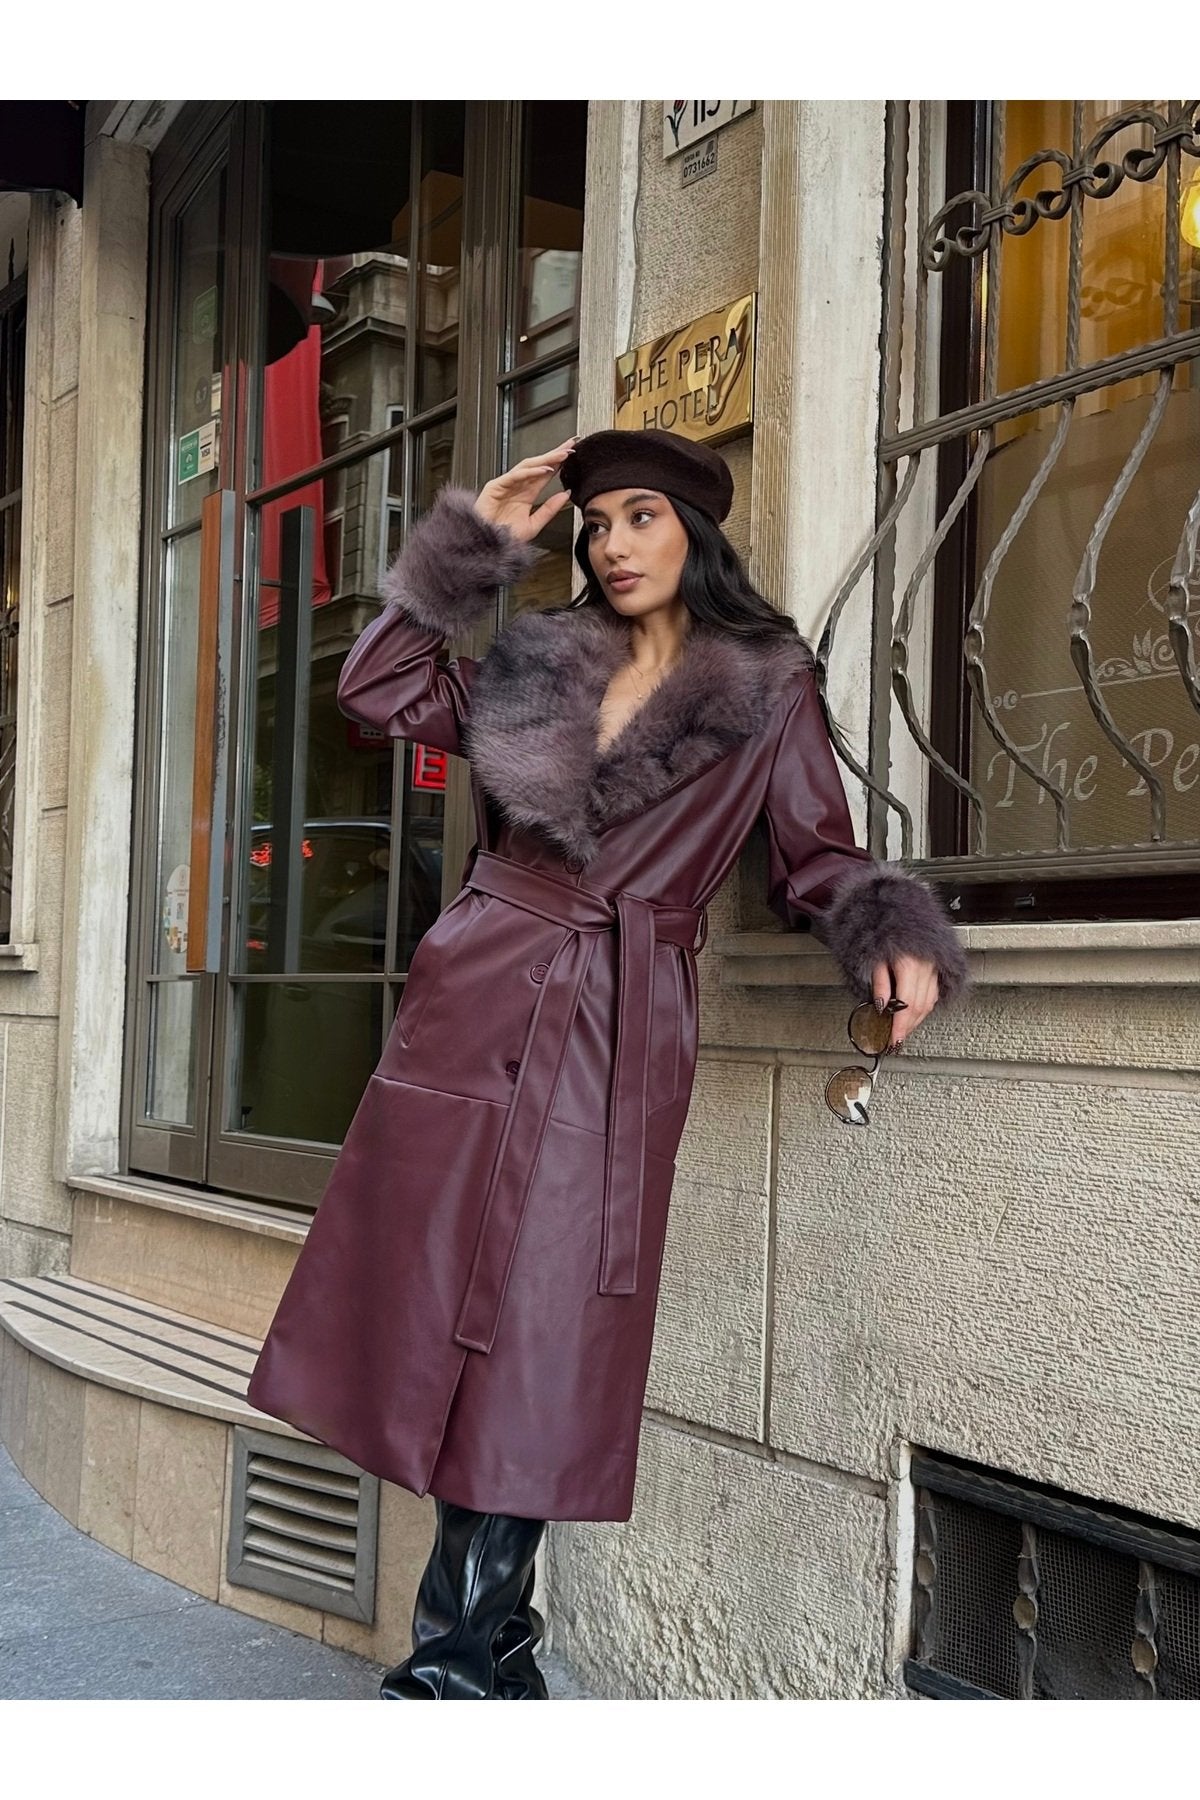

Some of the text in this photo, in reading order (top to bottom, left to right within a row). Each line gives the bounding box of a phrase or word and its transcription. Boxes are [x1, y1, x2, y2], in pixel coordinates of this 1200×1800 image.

[624, 327, 742, 402] THE PERA
[643, 383, 718, 431] HOTEL
[986, 721, 1099, 808] The
